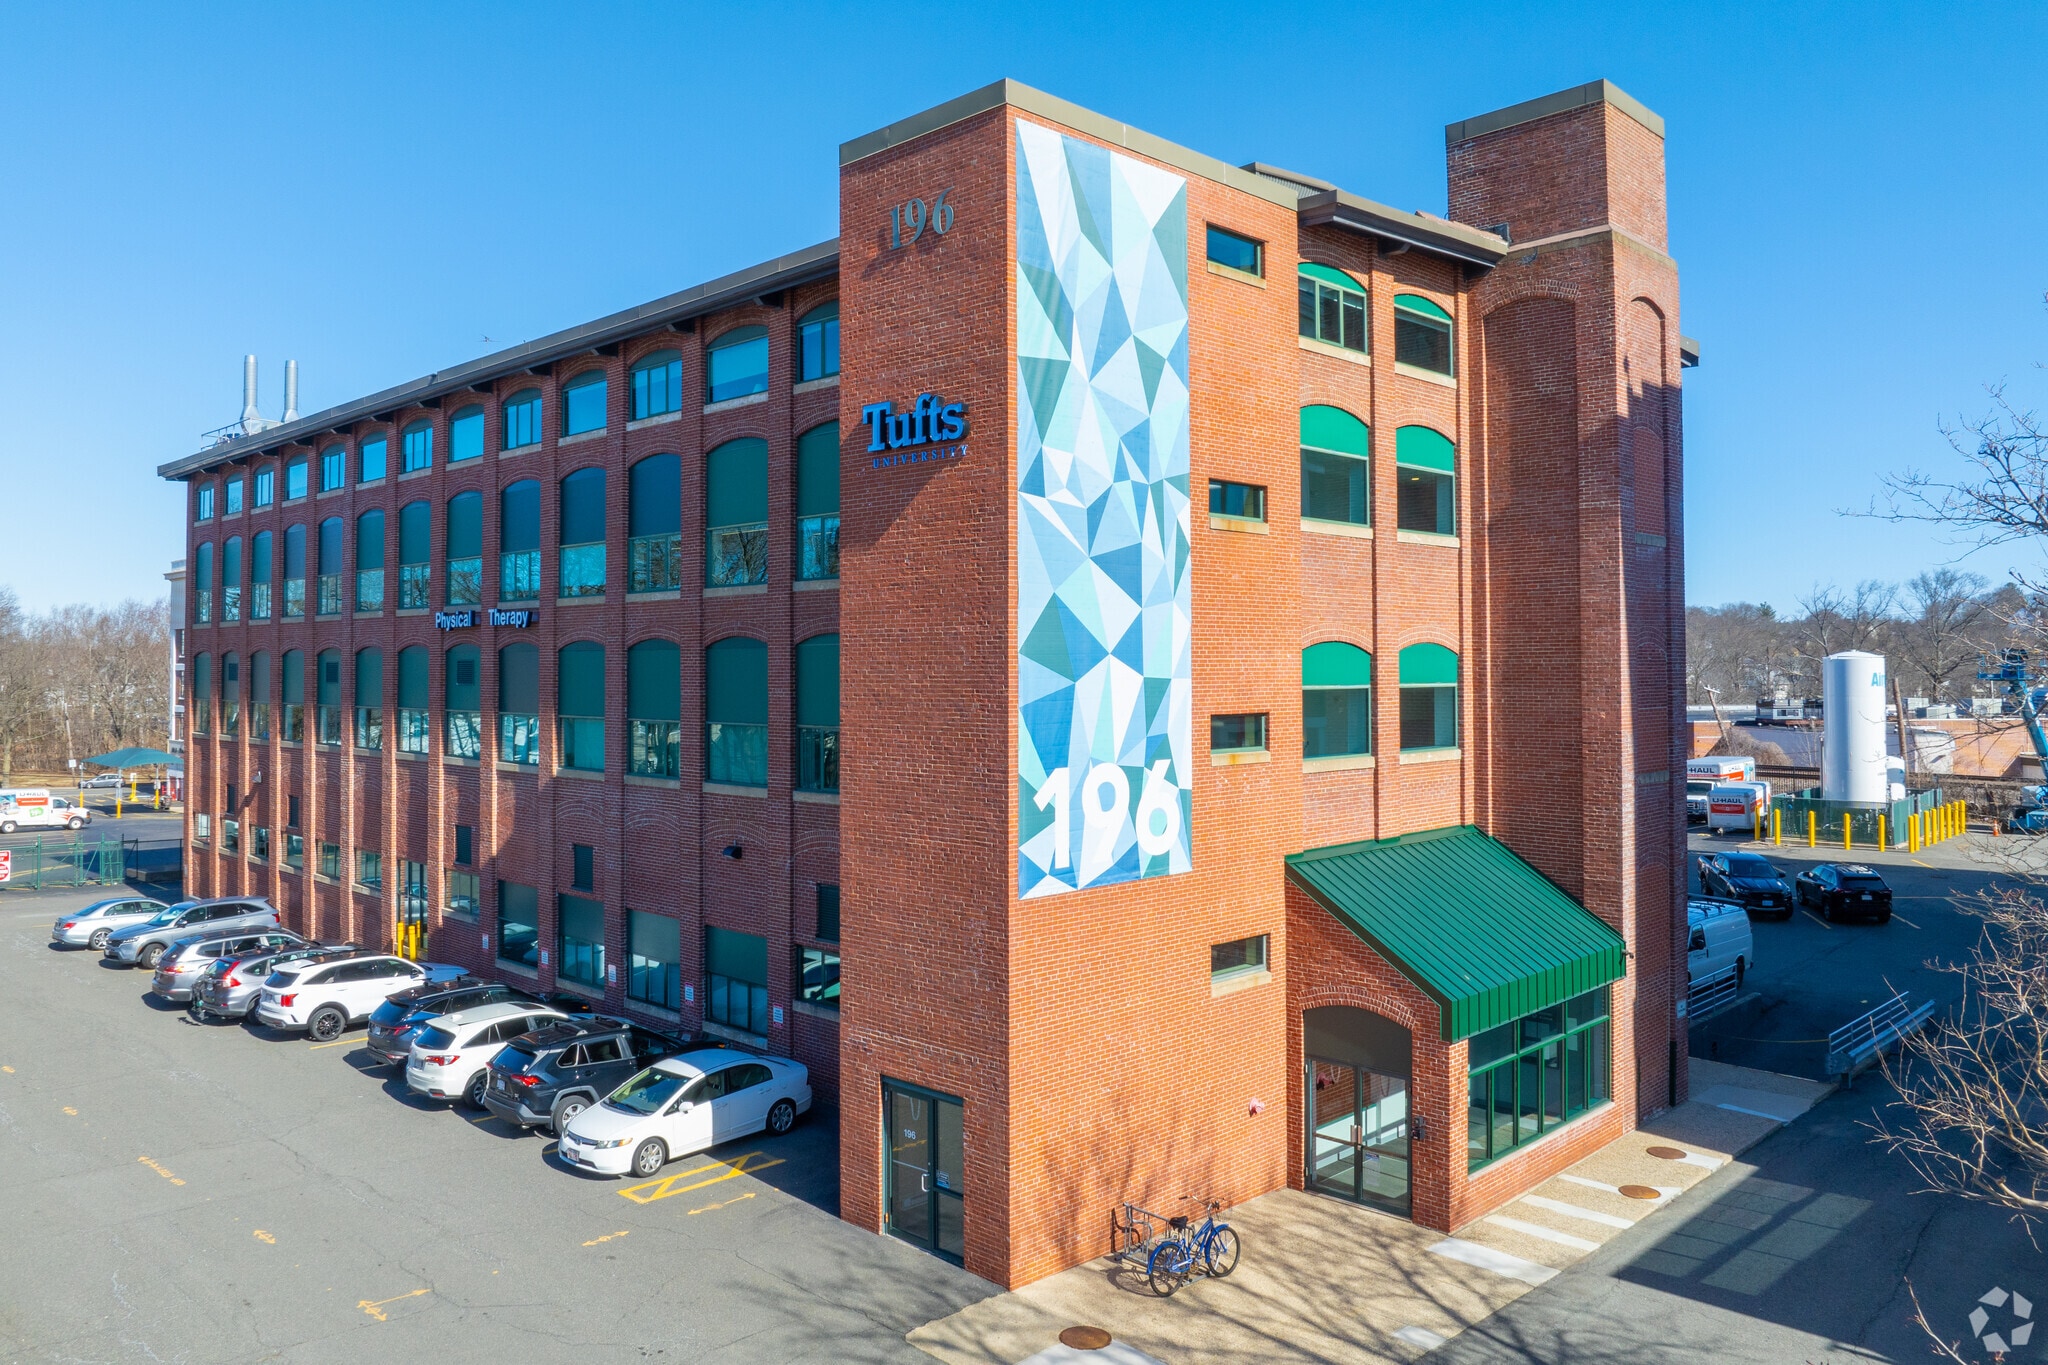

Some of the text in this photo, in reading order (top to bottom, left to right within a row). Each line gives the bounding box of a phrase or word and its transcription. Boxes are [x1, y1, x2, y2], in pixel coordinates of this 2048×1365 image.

[889, 186, 955, 251] 196
[862, 392, 968, 453] Tufts
[872, 444, 968, 469] UNIVERSITY
[435, 609, 529, 632] Physical Therapy
[1032, 758, 1181, 870] 196
[903, 1128, 917, 1140] 196
